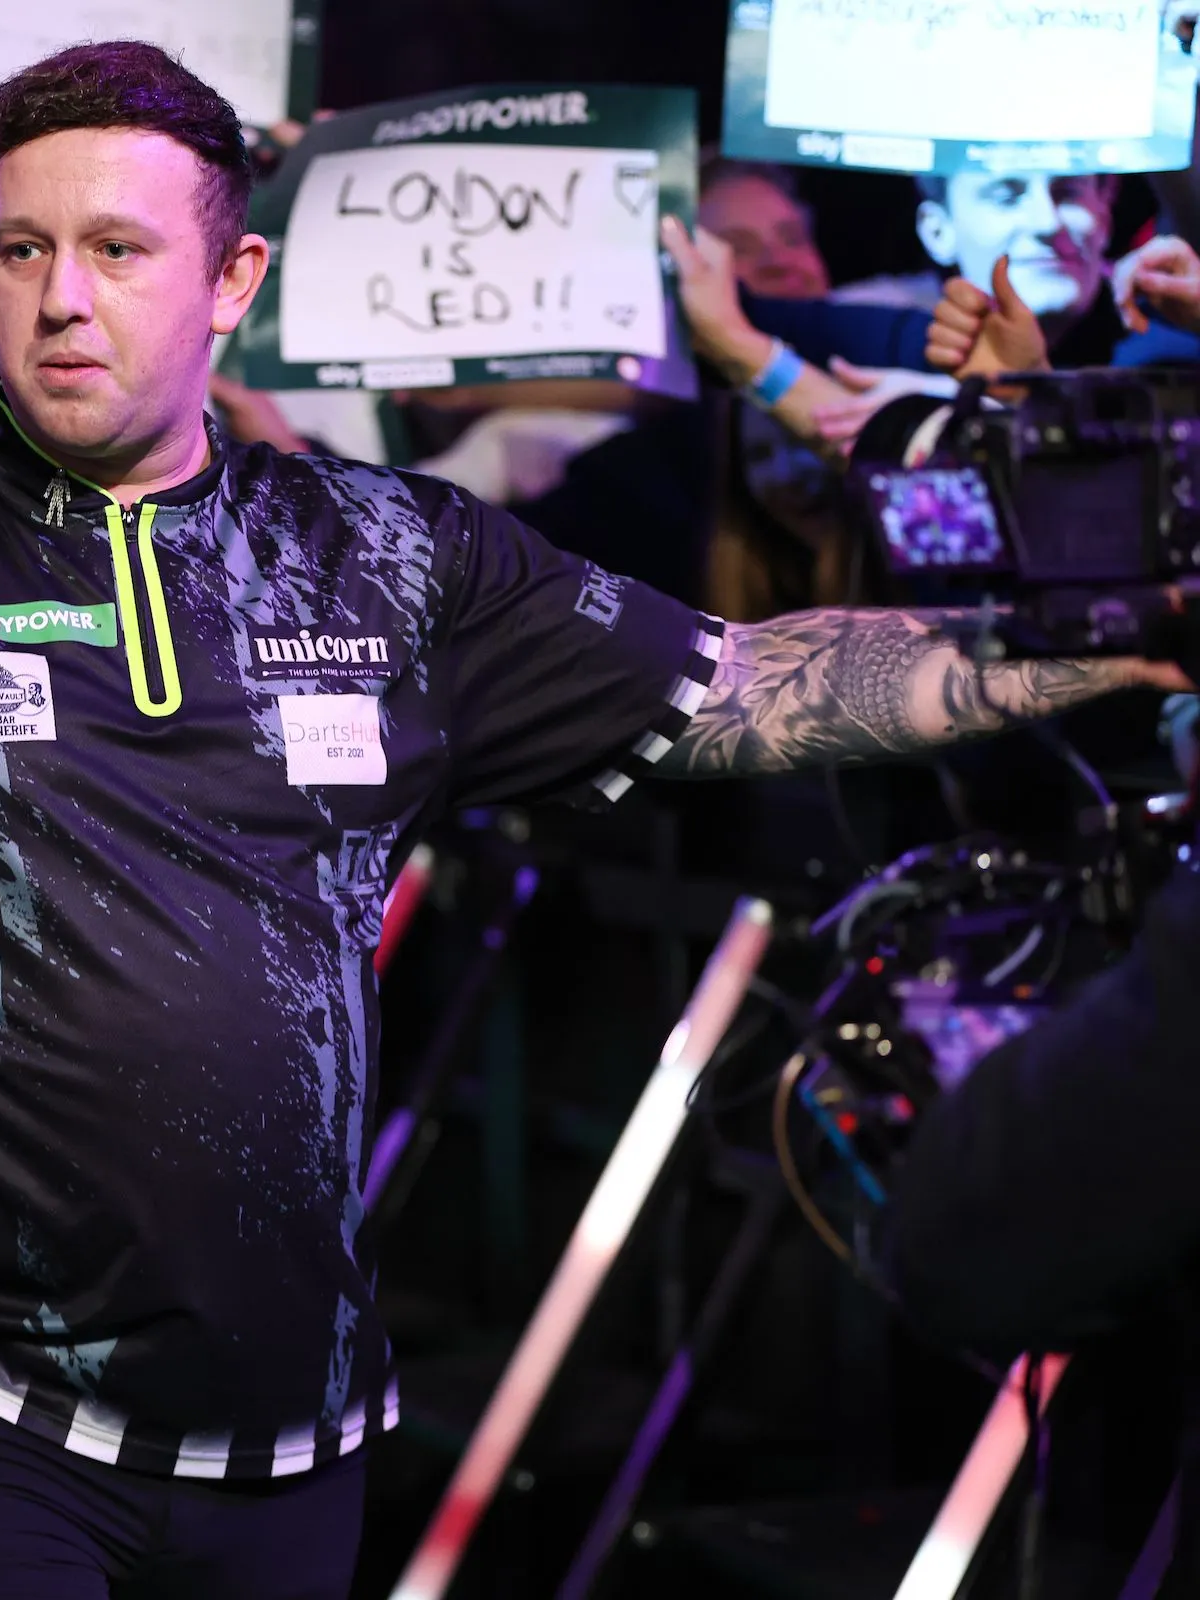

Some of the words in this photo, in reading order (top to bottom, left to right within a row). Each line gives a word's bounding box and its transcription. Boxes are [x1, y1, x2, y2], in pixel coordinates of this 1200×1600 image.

[336, 166, 581, 236] LONDON
[422, 241, 475, 277] IS
[254, 629, 389, 664] unicorn
[288, 668, 304, 677] THE
[304, 668, 320, 677] BIG
[339, 669, 348, 677] IN
[348, 669, 374, 677] DARTS
[347, 747, 364, 758] 2021
